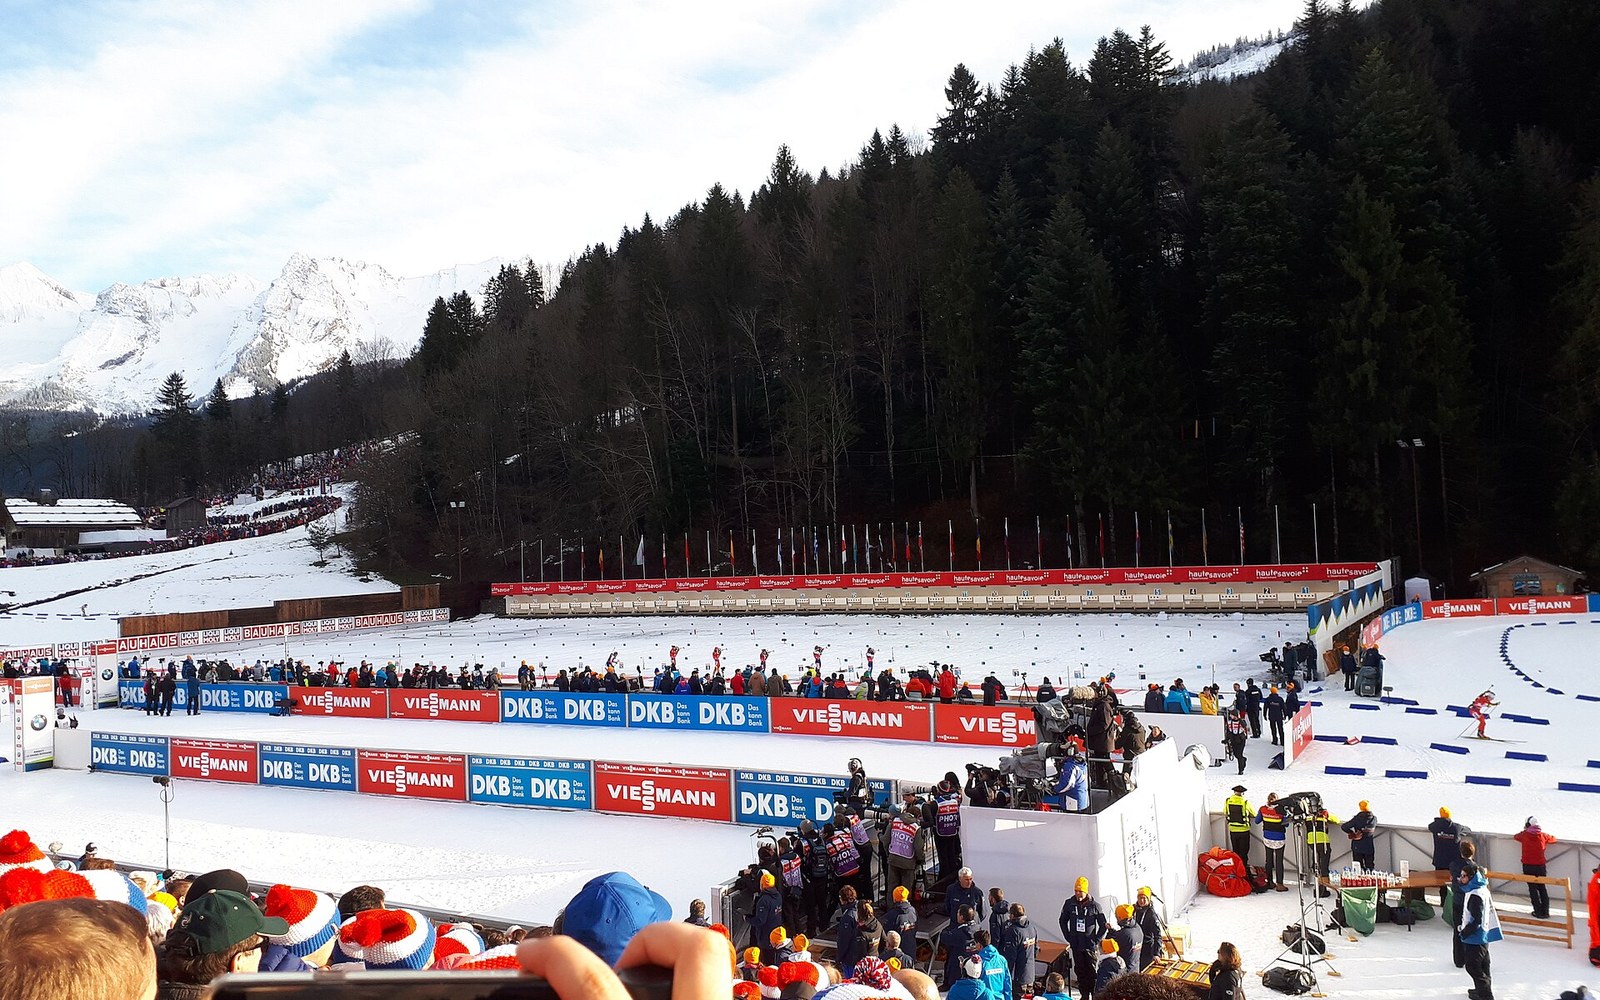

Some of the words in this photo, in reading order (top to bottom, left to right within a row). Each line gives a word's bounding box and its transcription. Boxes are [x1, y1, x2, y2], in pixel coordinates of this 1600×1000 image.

[1431, 602, 1481, 617] VIESSMANN
[1509, 599, 1571, 614] VIESSMANN
[355, 614, 403, 628] BAUHAUS
[119, 634, 177, 650] AUHAUS
[202, 689, 230, 707] DKB
[244, 690, 274, 708] DKB
[302, 691, 371, 713] VIESSMANN
[404, 693, 480, 717] VIESSMANN
[504, 698, 543, 718] DKB
[564, 699, 605, 721] DKB
[631, 701, 675, 723] DKB
[700, 702, 746, 726] DKB
[749, 719, 763, 727] Bank
[792, 704, 903, 732] VIESSMANN
[960, 712, 1035, 743] VIESSM
[93, 747, 118, 765] DKB
[130, 750, 156, 768] DKB
[178, 752, 248, 776] VIESSMANN
[514, 759, 525, 767] DKB
[558, 761, 570, 769] DKB
[263, 760, 293, 779] DKB
[309, 763, 340, 783] DKB
[368, 765, 454, 793] VIESSMANN
[472, 775, 511, 796] DKB
[531, 777, 571, 800] DKB
[740, 772, 754, 780] DKB
[758, 773, 771, 781] DKB
[775, 775, 789, 783] DKB
[794, 776, 808, 784] DKB
[812, 777, 826, 785] DKB
[831, 778, 845, 787] DKB
[573, 794, 586, 802] Bank
[607, 780, 716, 811] VIESSMANN
[741, 791, 789, 818] DKB
[791, 795, 803, 803] Das
[792, 811, 806, 820] Bank
